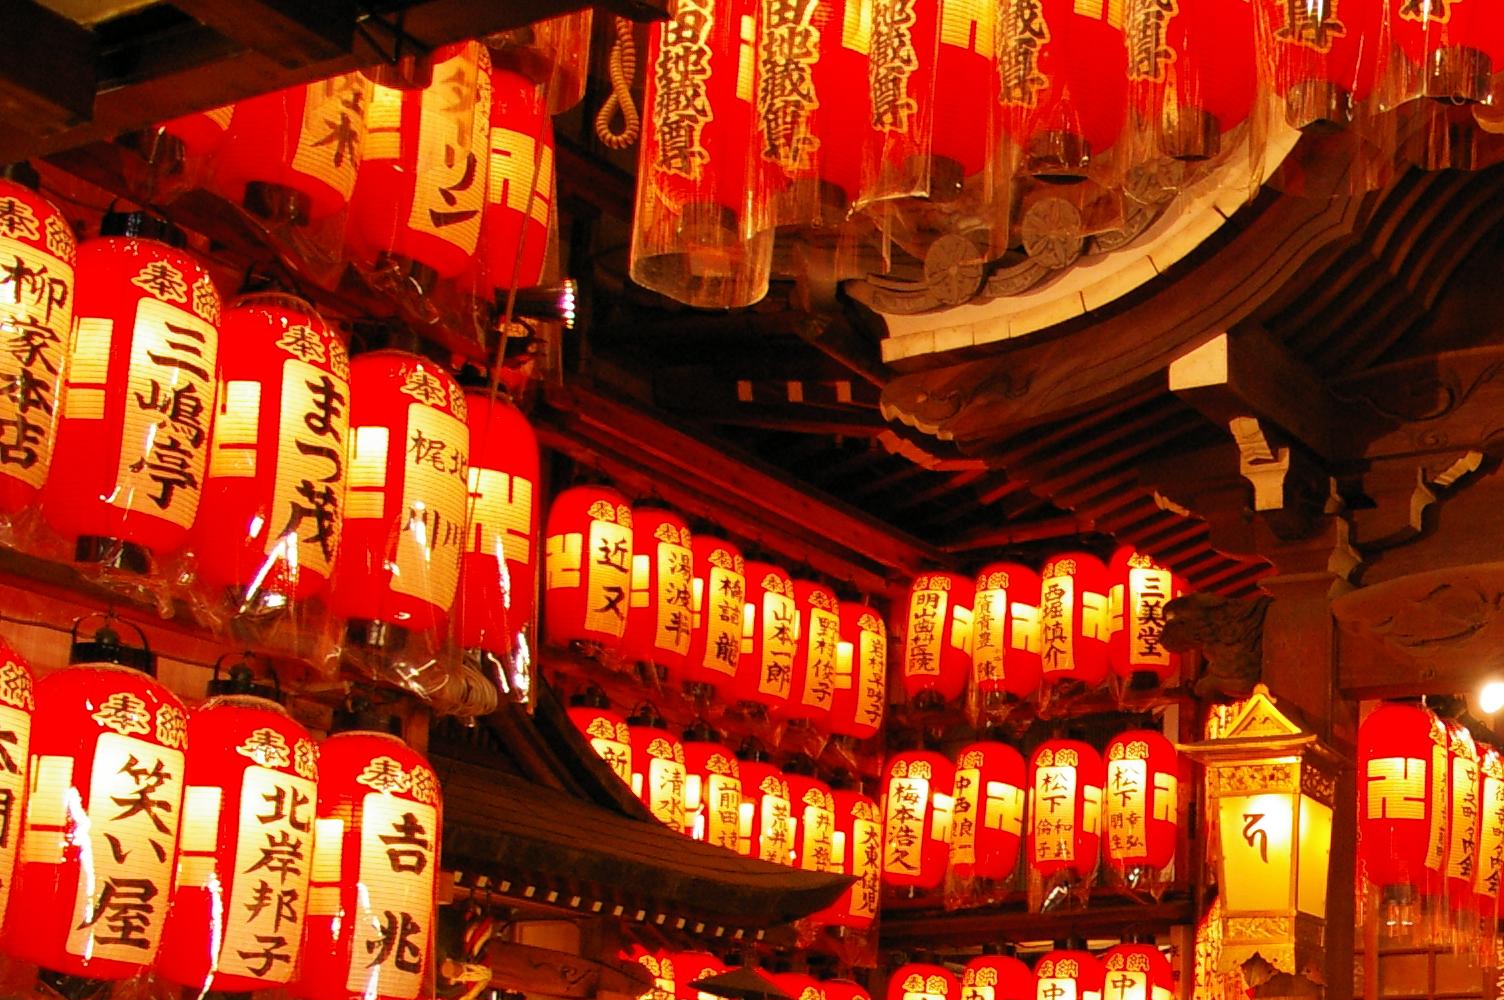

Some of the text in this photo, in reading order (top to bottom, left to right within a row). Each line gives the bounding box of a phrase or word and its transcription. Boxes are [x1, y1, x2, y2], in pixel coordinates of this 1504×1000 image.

[131, 257, 221, 328] 奉納
[0, 255, 66, 470] 柳家本店
[275, 323, 350, 383] 奉納
[400, 371, 468, 423] 奉納
[277, 376, 346, 564] まつ茂
[595, 538, 630, 622] 近又
[1137, 577, 1167, 657] 三美堂
[92, 691, 188, 750] 奉納
[236, 728, 319, 786] 奉納
[356, 756, 438, 803] 奉納
[78, 753, 173, 950] 笑い屋
[238, 785, 312, 977] 北岸邦子
